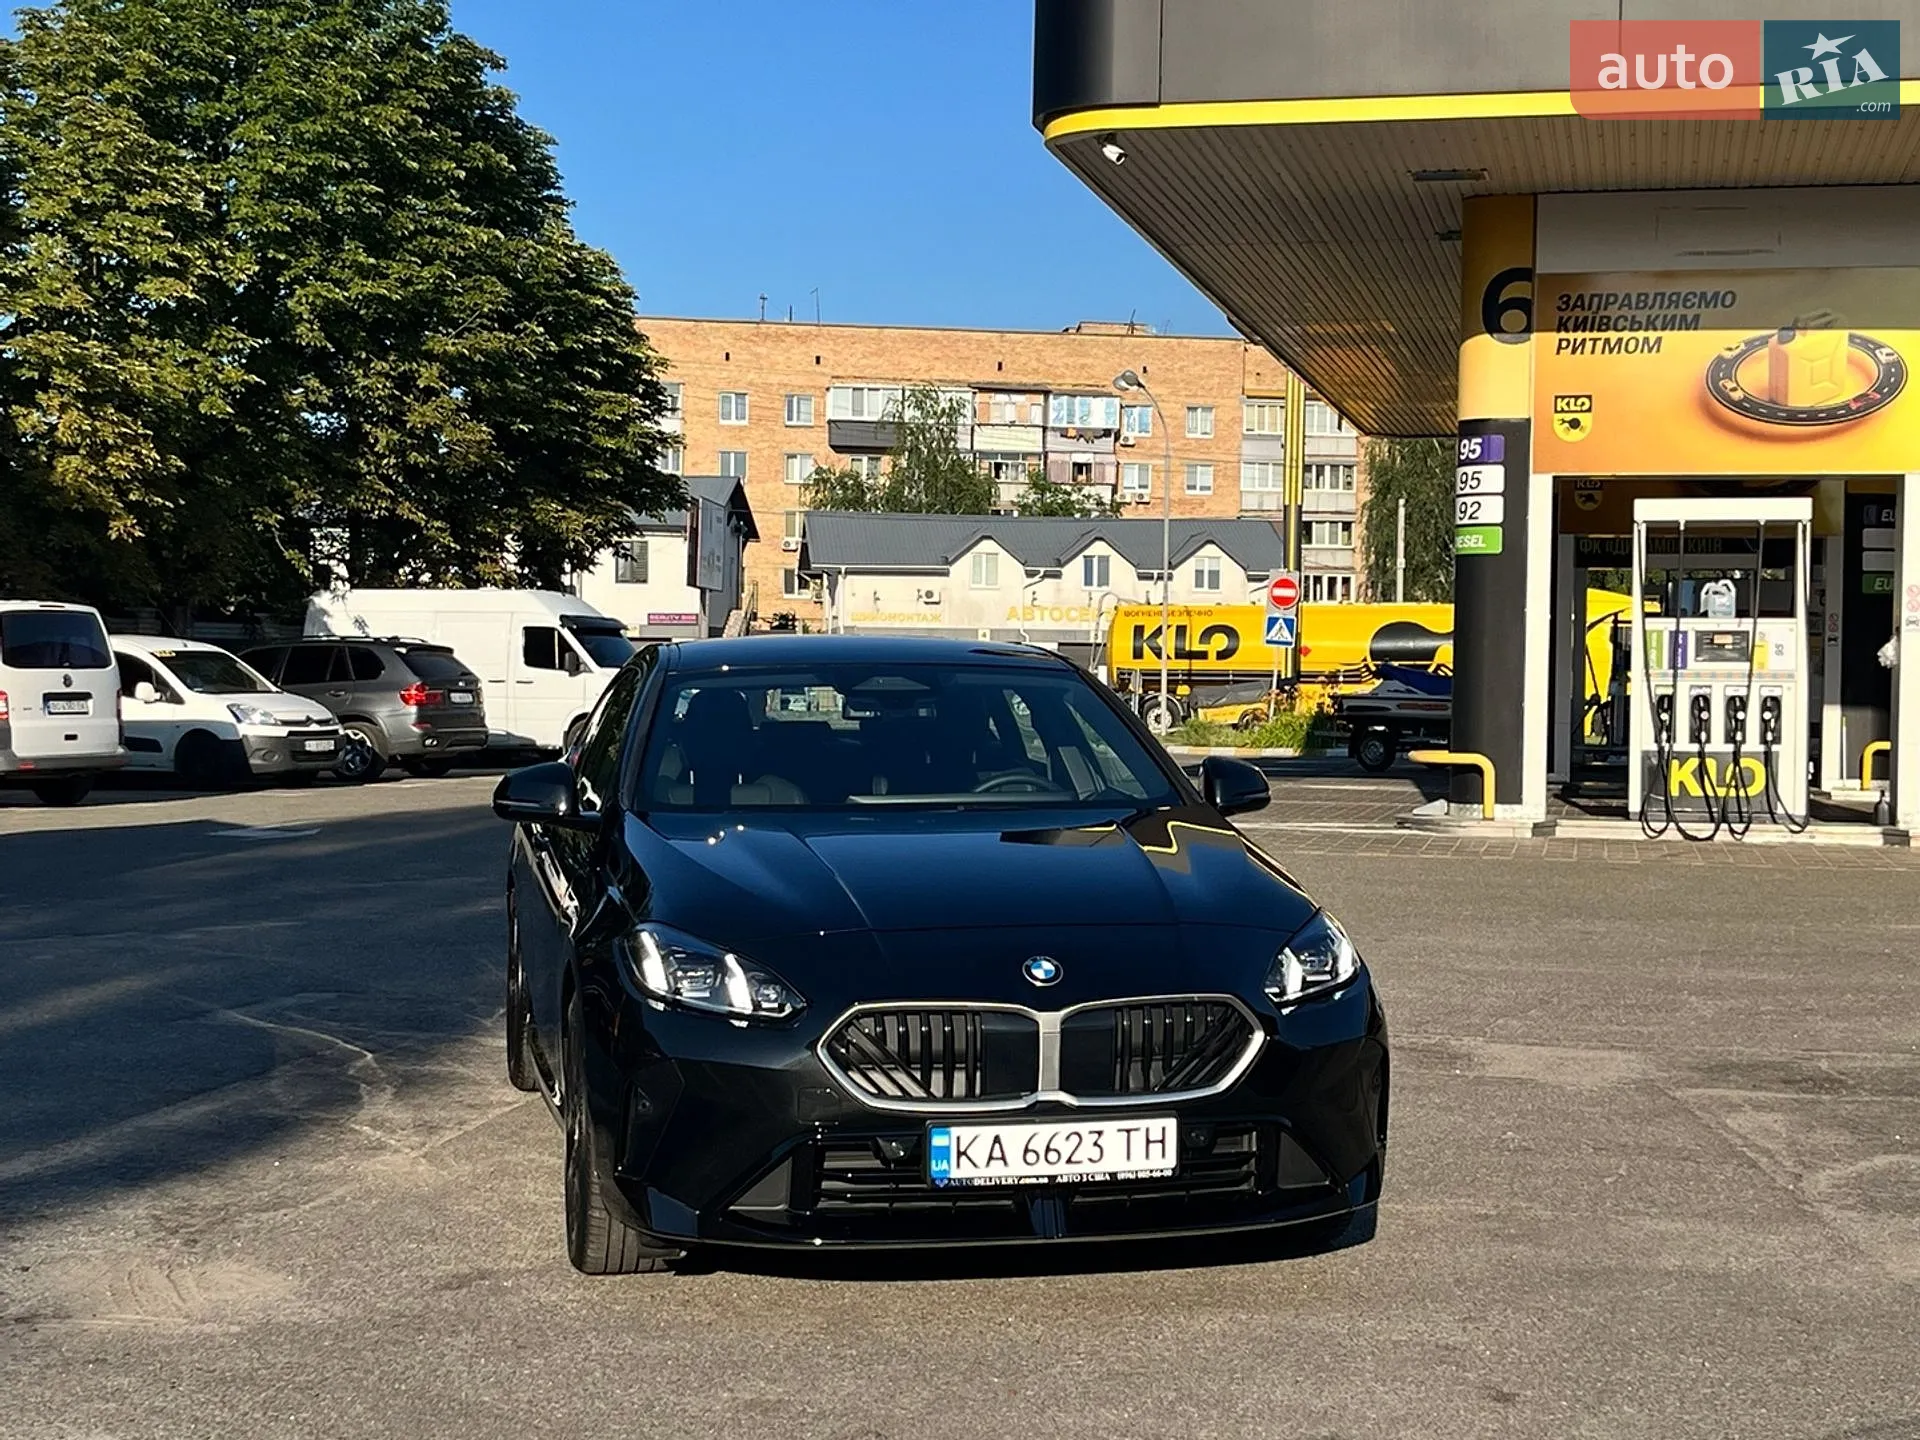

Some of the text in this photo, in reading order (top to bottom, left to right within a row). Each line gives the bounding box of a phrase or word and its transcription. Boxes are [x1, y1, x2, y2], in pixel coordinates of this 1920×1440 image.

[1481, 267, 1532, 345] 6
[1556, 290, 1737, 312] ЗАПРАВЛЯЄМО
[1556, 312, 1701, 334] КИЇВСЬКИМ
[1556, 336, 1662, 356] РИТМОМ
[1555, 396, 1591, 412] KLO
[1459, 438, 1482, 460] 95
[1459, 471, 1482, 491] 95
[1458, 501, 1482, 521] 92
[1132, 624, 1241, 661] KLO
[1670, 757, 1767, 797] KLO
[956, 1126, 1167, 1169] KA 6623 TH
[932, 1159, 949, 1171] UA
